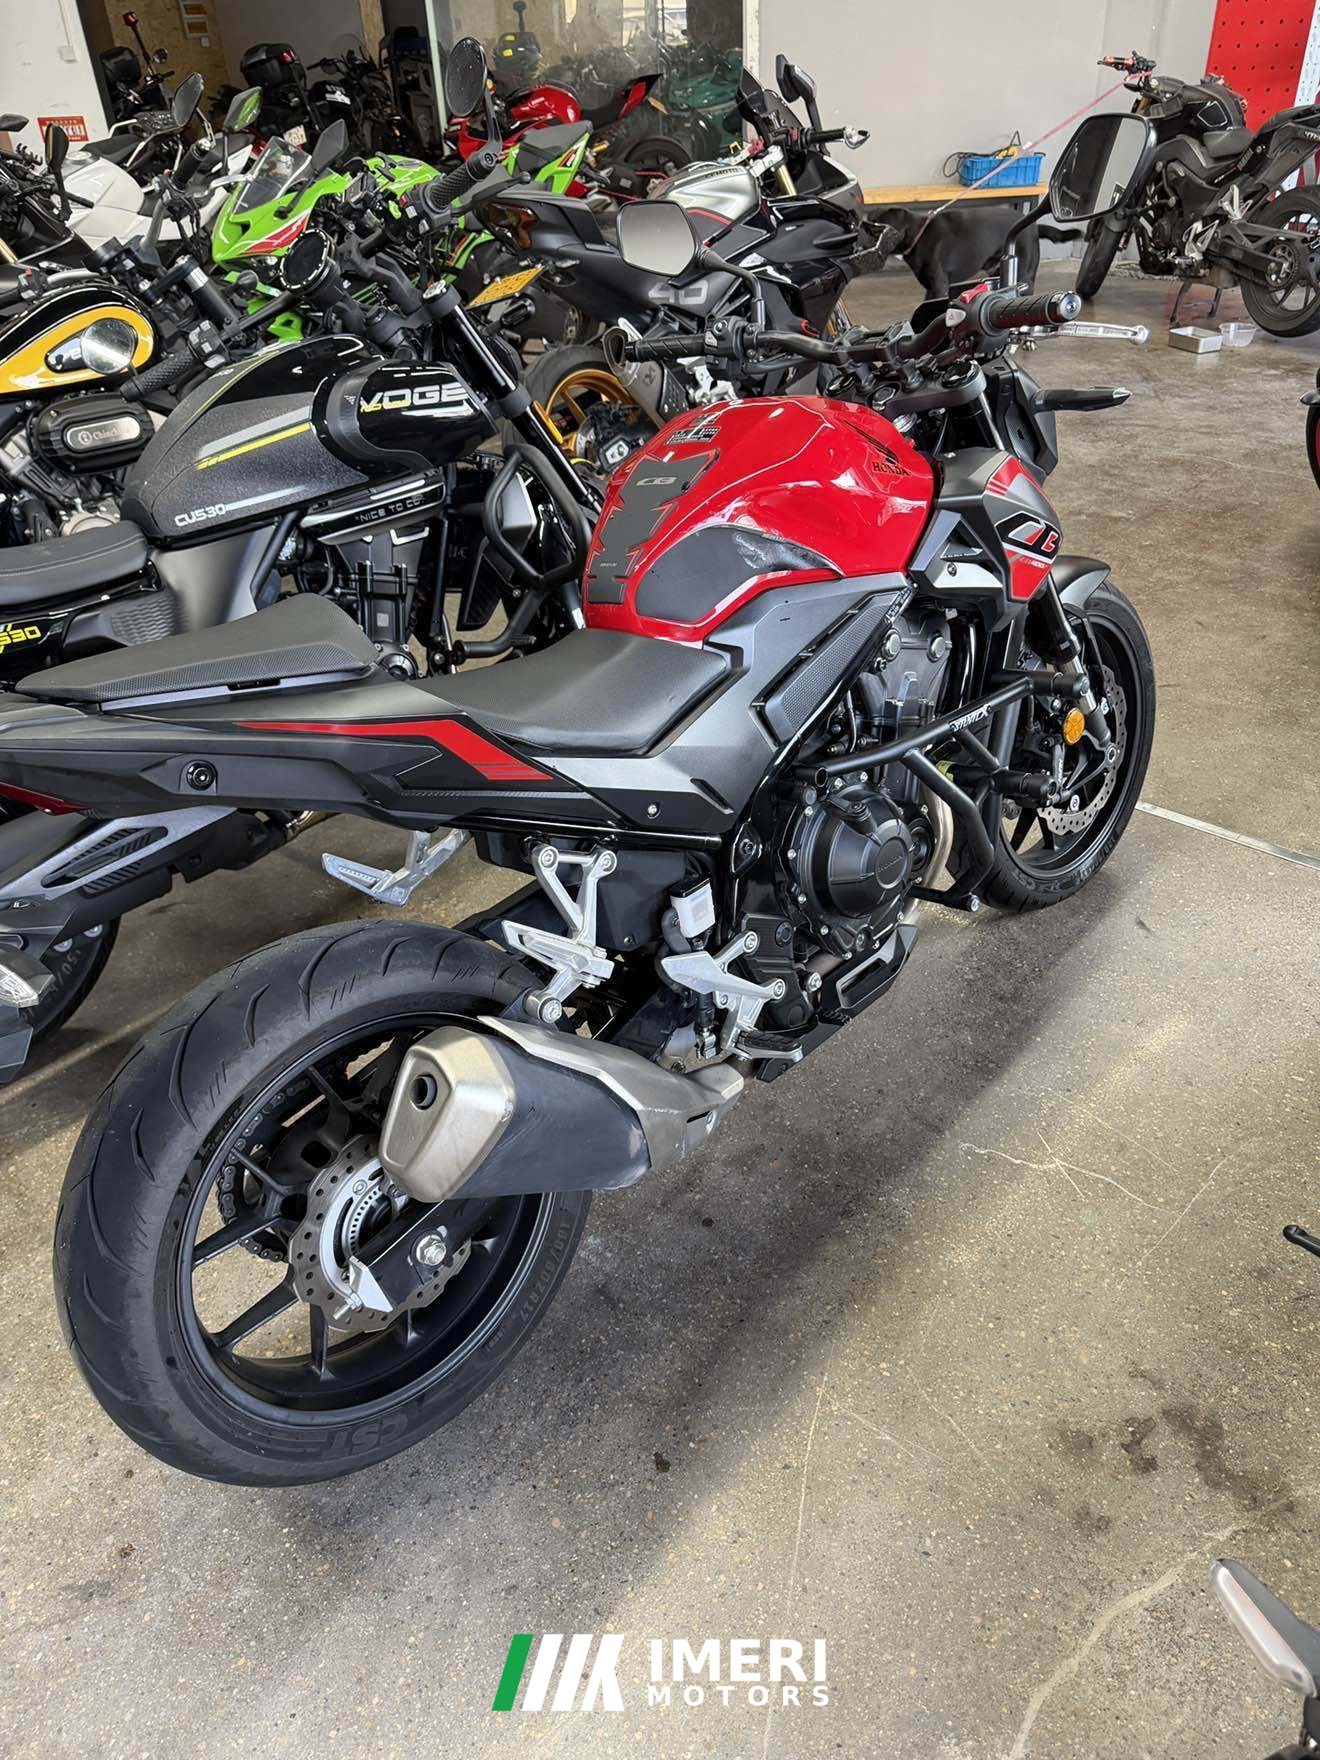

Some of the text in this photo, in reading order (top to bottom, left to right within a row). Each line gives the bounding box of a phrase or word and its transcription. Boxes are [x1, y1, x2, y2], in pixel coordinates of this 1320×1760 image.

[360, 381, 469, 413] VOGE
[871, 461, 911, 477] HONDA
[174, 503, 227, 527] CU530
[388, 502, 403, 514] TO
